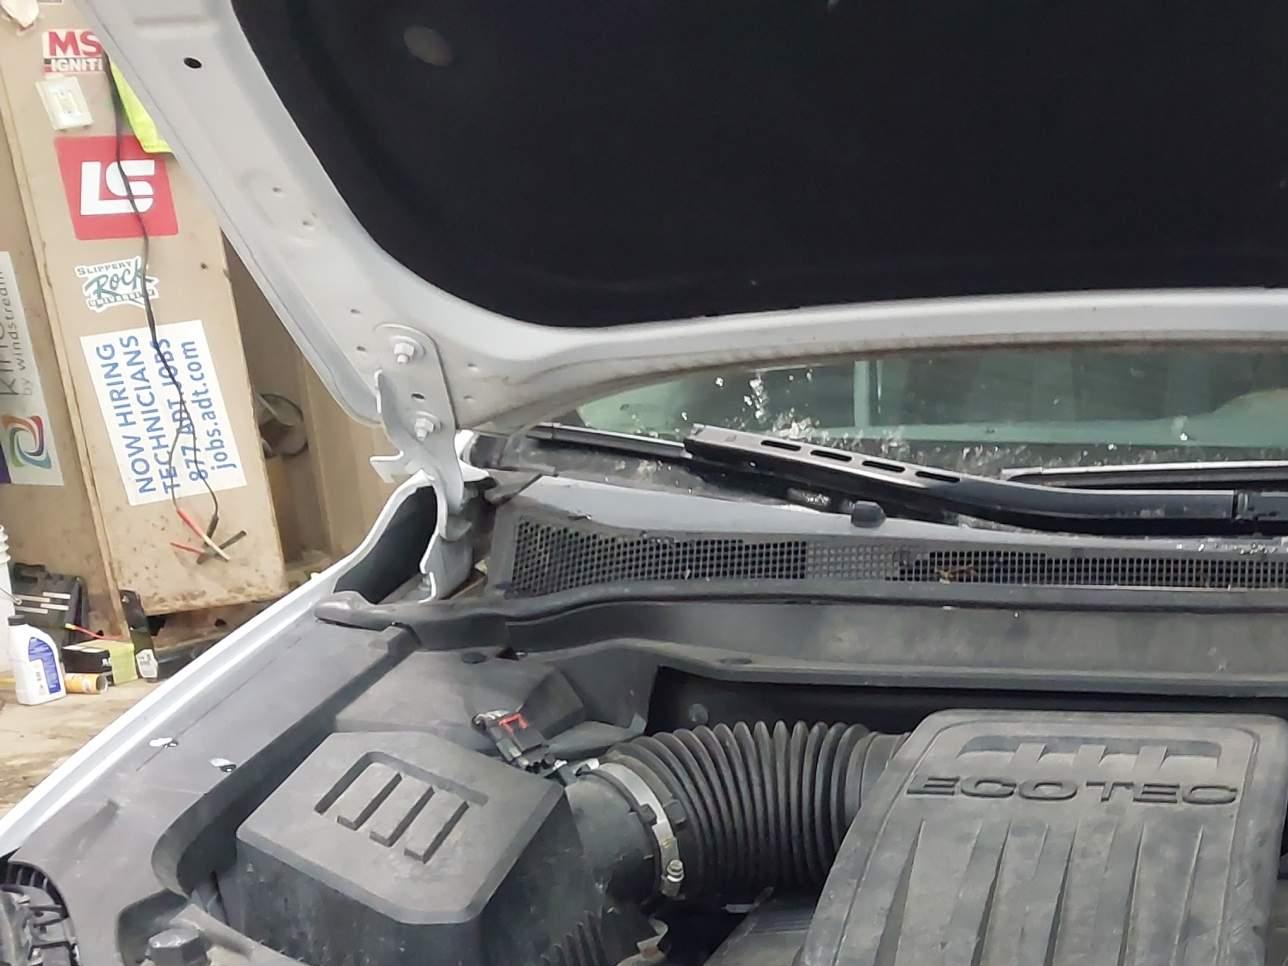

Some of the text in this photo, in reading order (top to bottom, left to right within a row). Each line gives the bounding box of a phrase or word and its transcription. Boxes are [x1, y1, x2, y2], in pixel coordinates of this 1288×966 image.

[95, 343, 137, 427] HIRING
[119, 335, 181, 494] TECHNICIANS
[181, 340, 238, 471] jobs.adt.com
[121, 434, 156, 494] NOW
[906, 776, 1238, 805] ECOTEC
